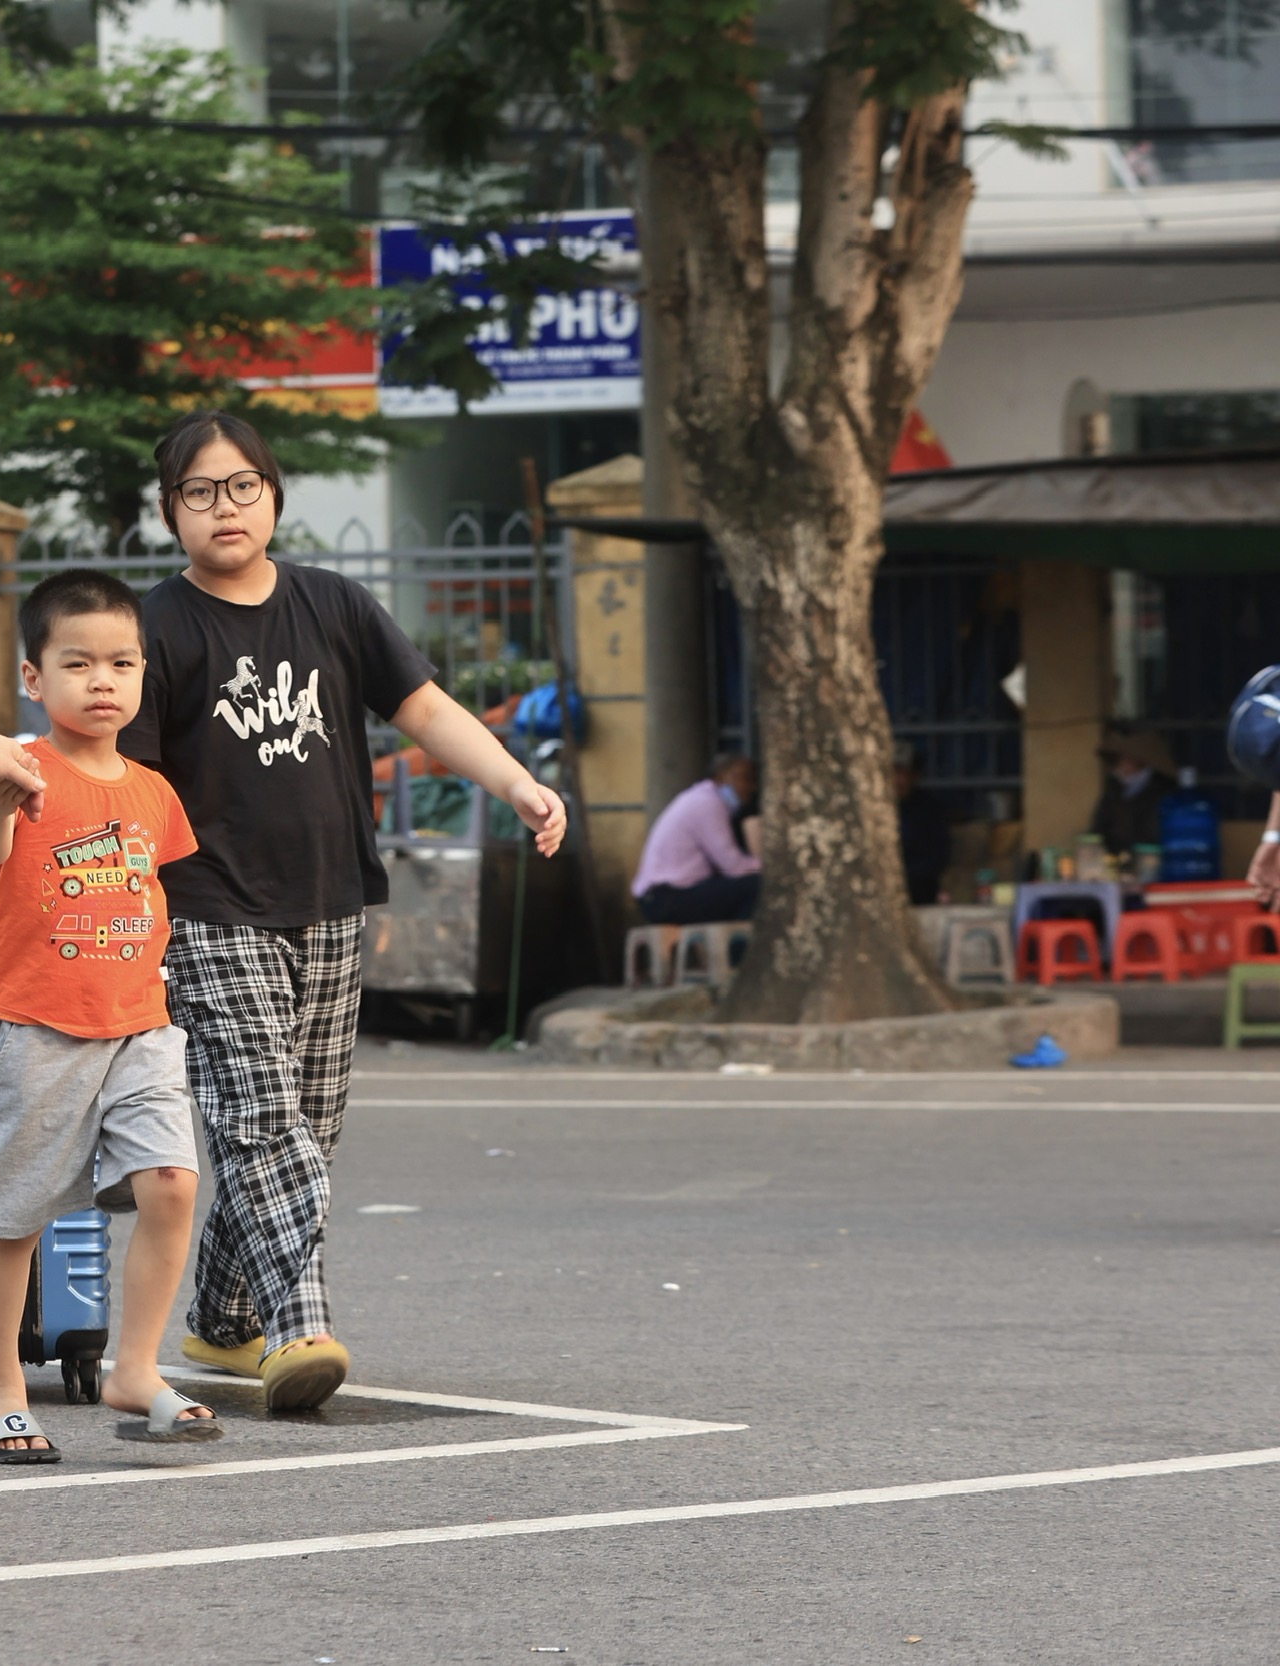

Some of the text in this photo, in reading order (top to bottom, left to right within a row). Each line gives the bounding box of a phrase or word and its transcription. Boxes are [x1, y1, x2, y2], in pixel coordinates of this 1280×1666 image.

[213, 661, 323, 739] Wild
[258, 735, 309, 766] one
[56, 835, 120, 868] TOUGH
[130, 857, 148, 866] GUYS
[86, 871, 124, 884] NEED
[111, 918, 153, 933] SLEEP
[3, 1414, 28, 1432] G
